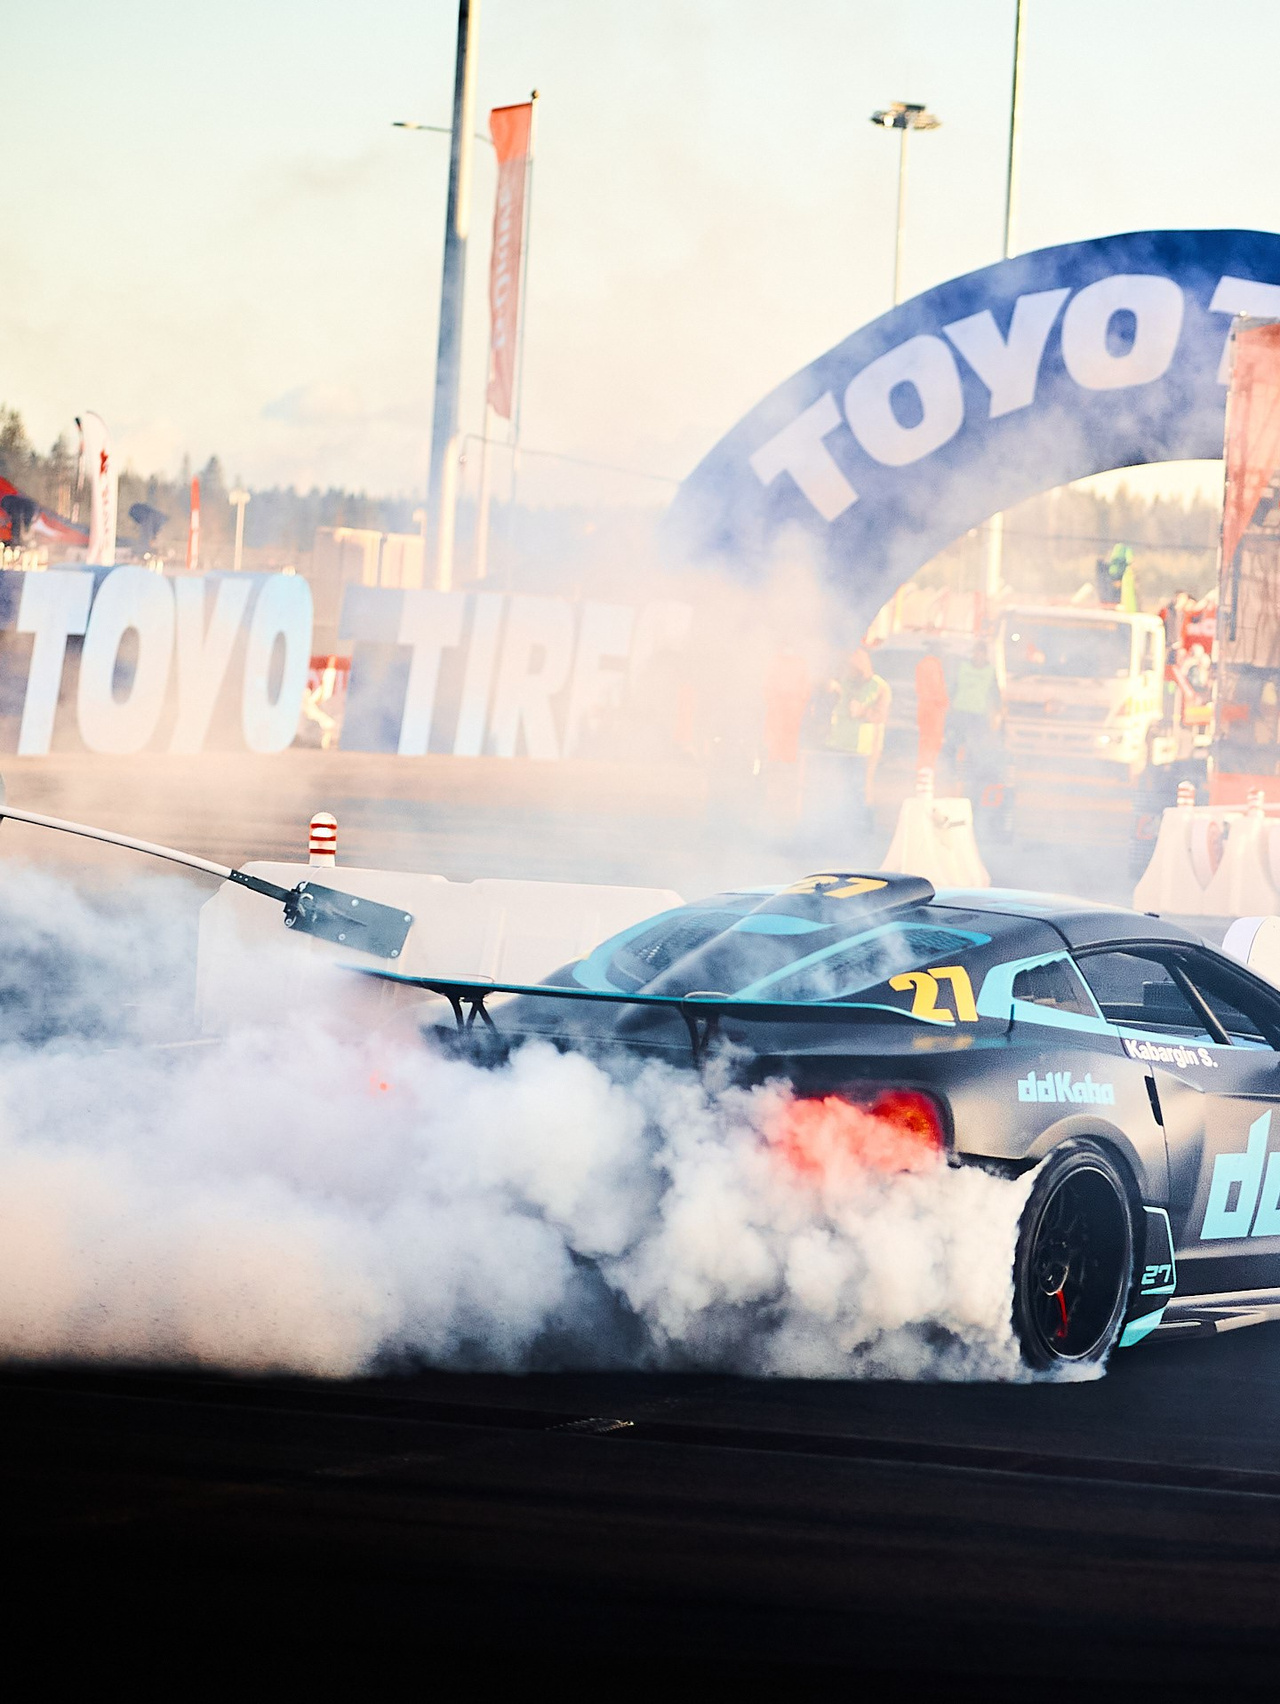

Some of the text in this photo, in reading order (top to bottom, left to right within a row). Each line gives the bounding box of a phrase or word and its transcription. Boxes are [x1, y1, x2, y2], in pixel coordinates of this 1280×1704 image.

[749, 273, 1185, 523] TOYO
[17, 564, 313, 757] TOYO
[888, 965, 979, 1022] 27
[1124, 1039, 1219, 1068] Kabargin S.
[1017, 1070, 1115, 1105] ddKaba
[1141, 1264, 1171, 1285] 27
